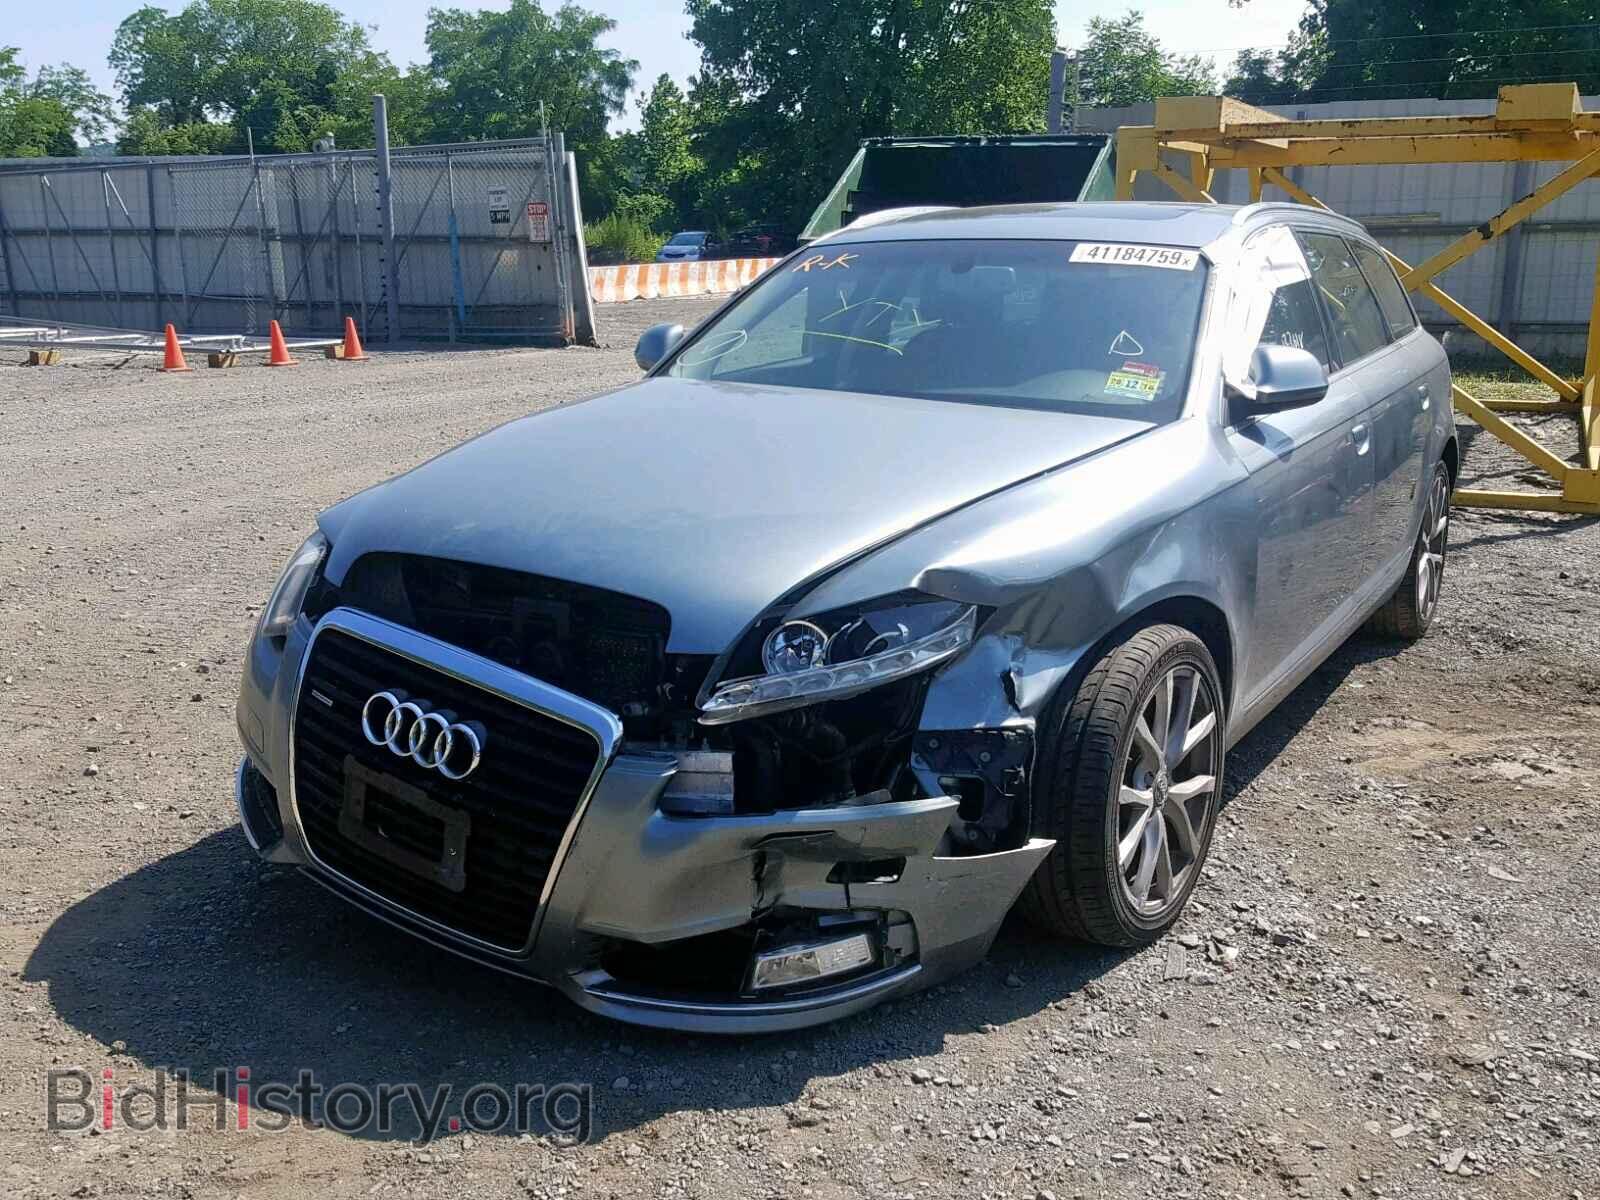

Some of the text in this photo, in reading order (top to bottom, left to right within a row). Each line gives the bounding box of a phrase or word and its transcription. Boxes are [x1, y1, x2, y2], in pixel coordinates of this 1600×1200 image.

[528, 206, 546, 215] STOP
[496, 211, 511, 222] MPH
[1126, 379, 1139, 390] 12
